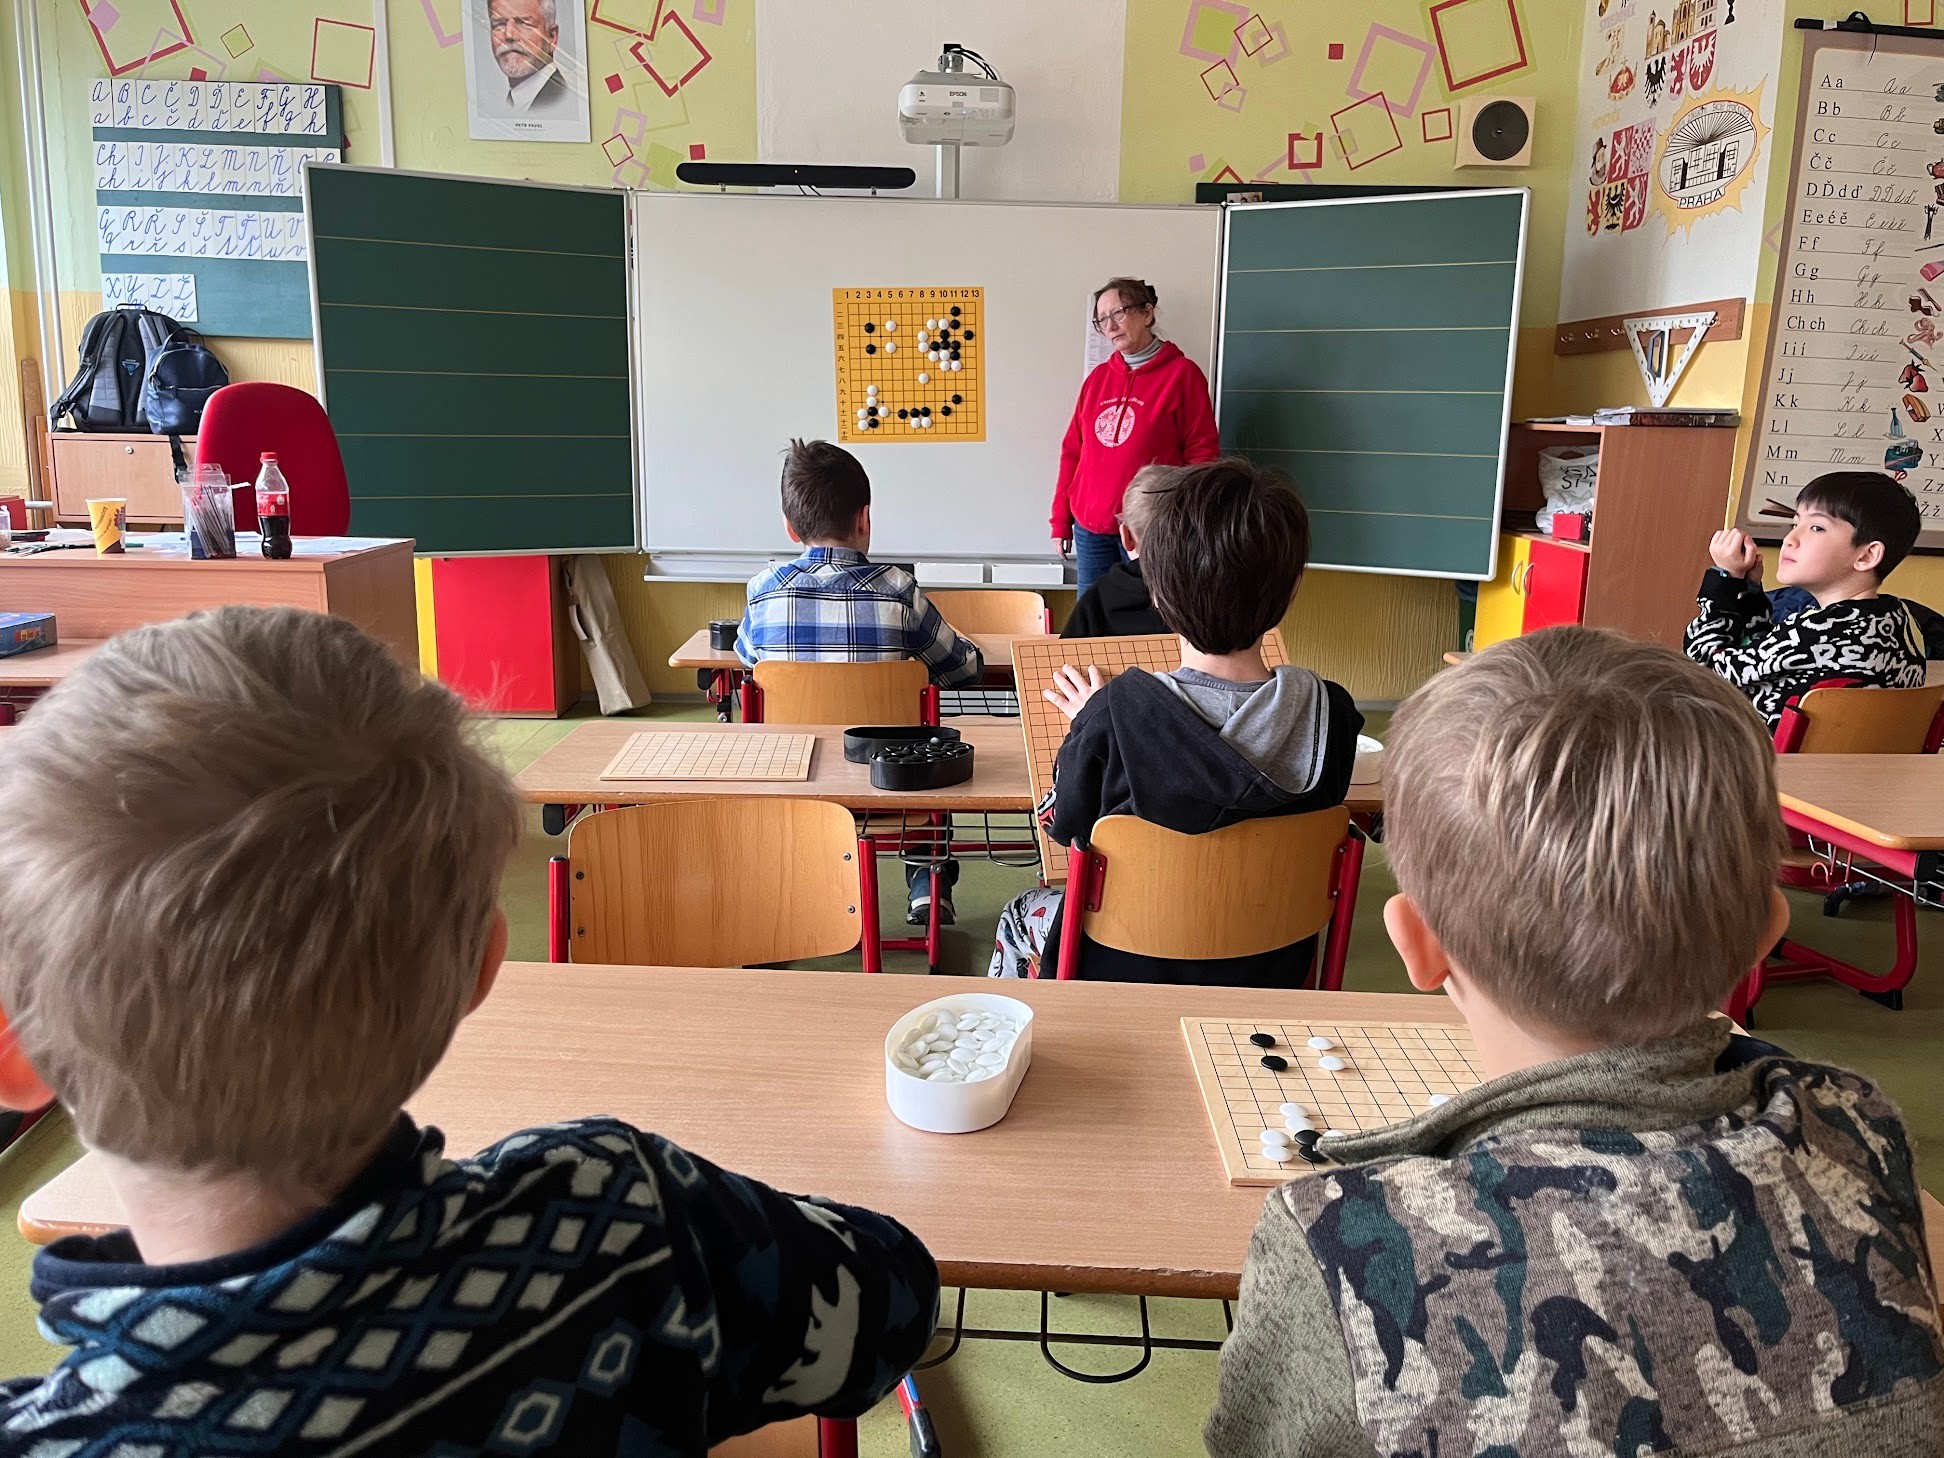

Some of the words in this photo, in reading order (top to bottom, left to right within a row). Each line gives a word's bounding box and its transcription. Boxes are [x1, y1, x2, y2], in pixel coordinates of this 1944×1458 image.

[1821, 74, 1832, 87] A
[1836, 79, 1843, 88] a
[1818, 101, 1827, 114] B
[1833, 102, 1841, 115] b
[1814, 129, 1824, 142] C
[1829, 133, 1836, 142] c
[1810, 152, 1821, 169] Č
[1825, 157, 1832, 169] č
[1806, 183, 1817, 196] D
[1823, 180, 1834, 196] Ď
[1839, 184, 1847, 197] d
[1851, 185, 1862, 198] ď
[1679, 187, 1722, 208] PRAHA
[1803, 210, 1812, 222] E
[1816, 214, 1824, 223] e
[1828, 211, 1835, 224] é
[1840, 212, 1847, 224] ě
[1799, 237, 1808, 249] F
[1812, 237, 1820, 249] f
[1795, 263, 1806, 276] G
[1809, 267, 1819, 280] g
[1791, 289, 1802, 302] H
[1807, 290, 1814, 303] h
[1787, 316, 1805, 329] Ch
[1810, 317, 1826, 330] ch
[1783, 342, 1788, 355] I
[1793, 342, 1797, 355] i
[1801, 343, 1806, 355] í
[1778, 368, 1785, 381] J
[1786, 369, 1793, 384] j
[1775, 394, 1786, 407] K
[1790, 394, 1799, 408] k
[841, 419, 847, 429] 十二
[1771, 420, 1781, 433] L
[1784, 420, 1788, 433] l
[1767, 445, 1781, 459] M
[1786, 449, 1798, 459] m
[1930, 454, 1939, 466] Y
[1765, 471, 1777, 484] N
[1780, 475, 1788, 484] n
[1923, 479, 1933, 491] Z
[1937, 483, 1943, 492] z
